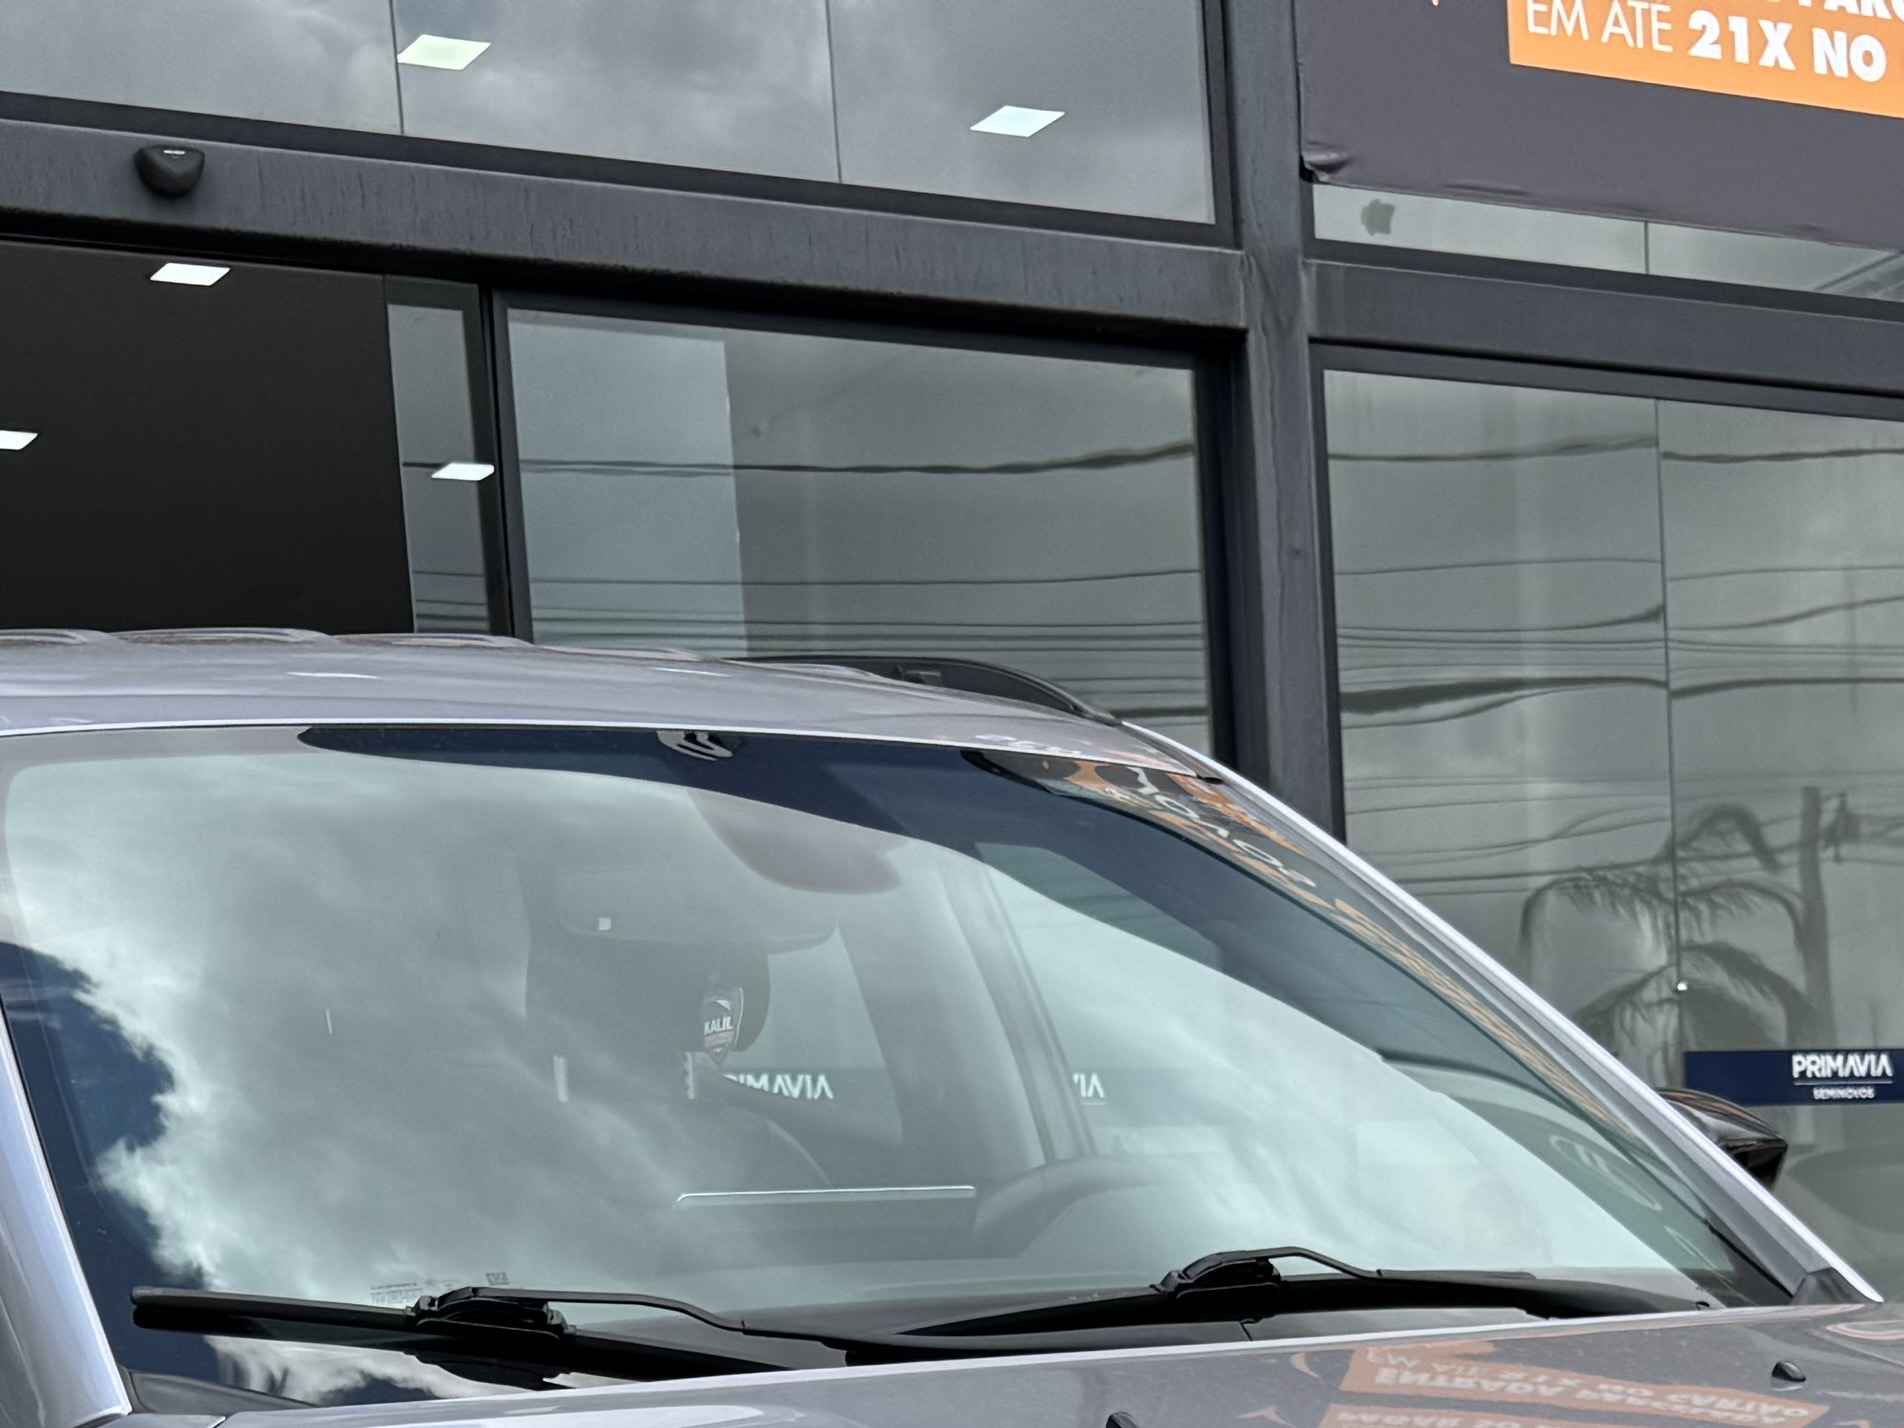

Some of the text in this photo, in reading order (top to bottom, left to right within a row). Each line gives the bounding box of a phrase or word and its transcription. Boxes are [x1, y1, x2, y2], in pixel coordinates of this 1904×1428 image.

[1527, 0, 1589, 41] EM
[1687, 9, 1796, 73] 21X
[1812, 27, 1887, 83] NO
[1792, 1052, 1893, 1079] PRIMAVIA
